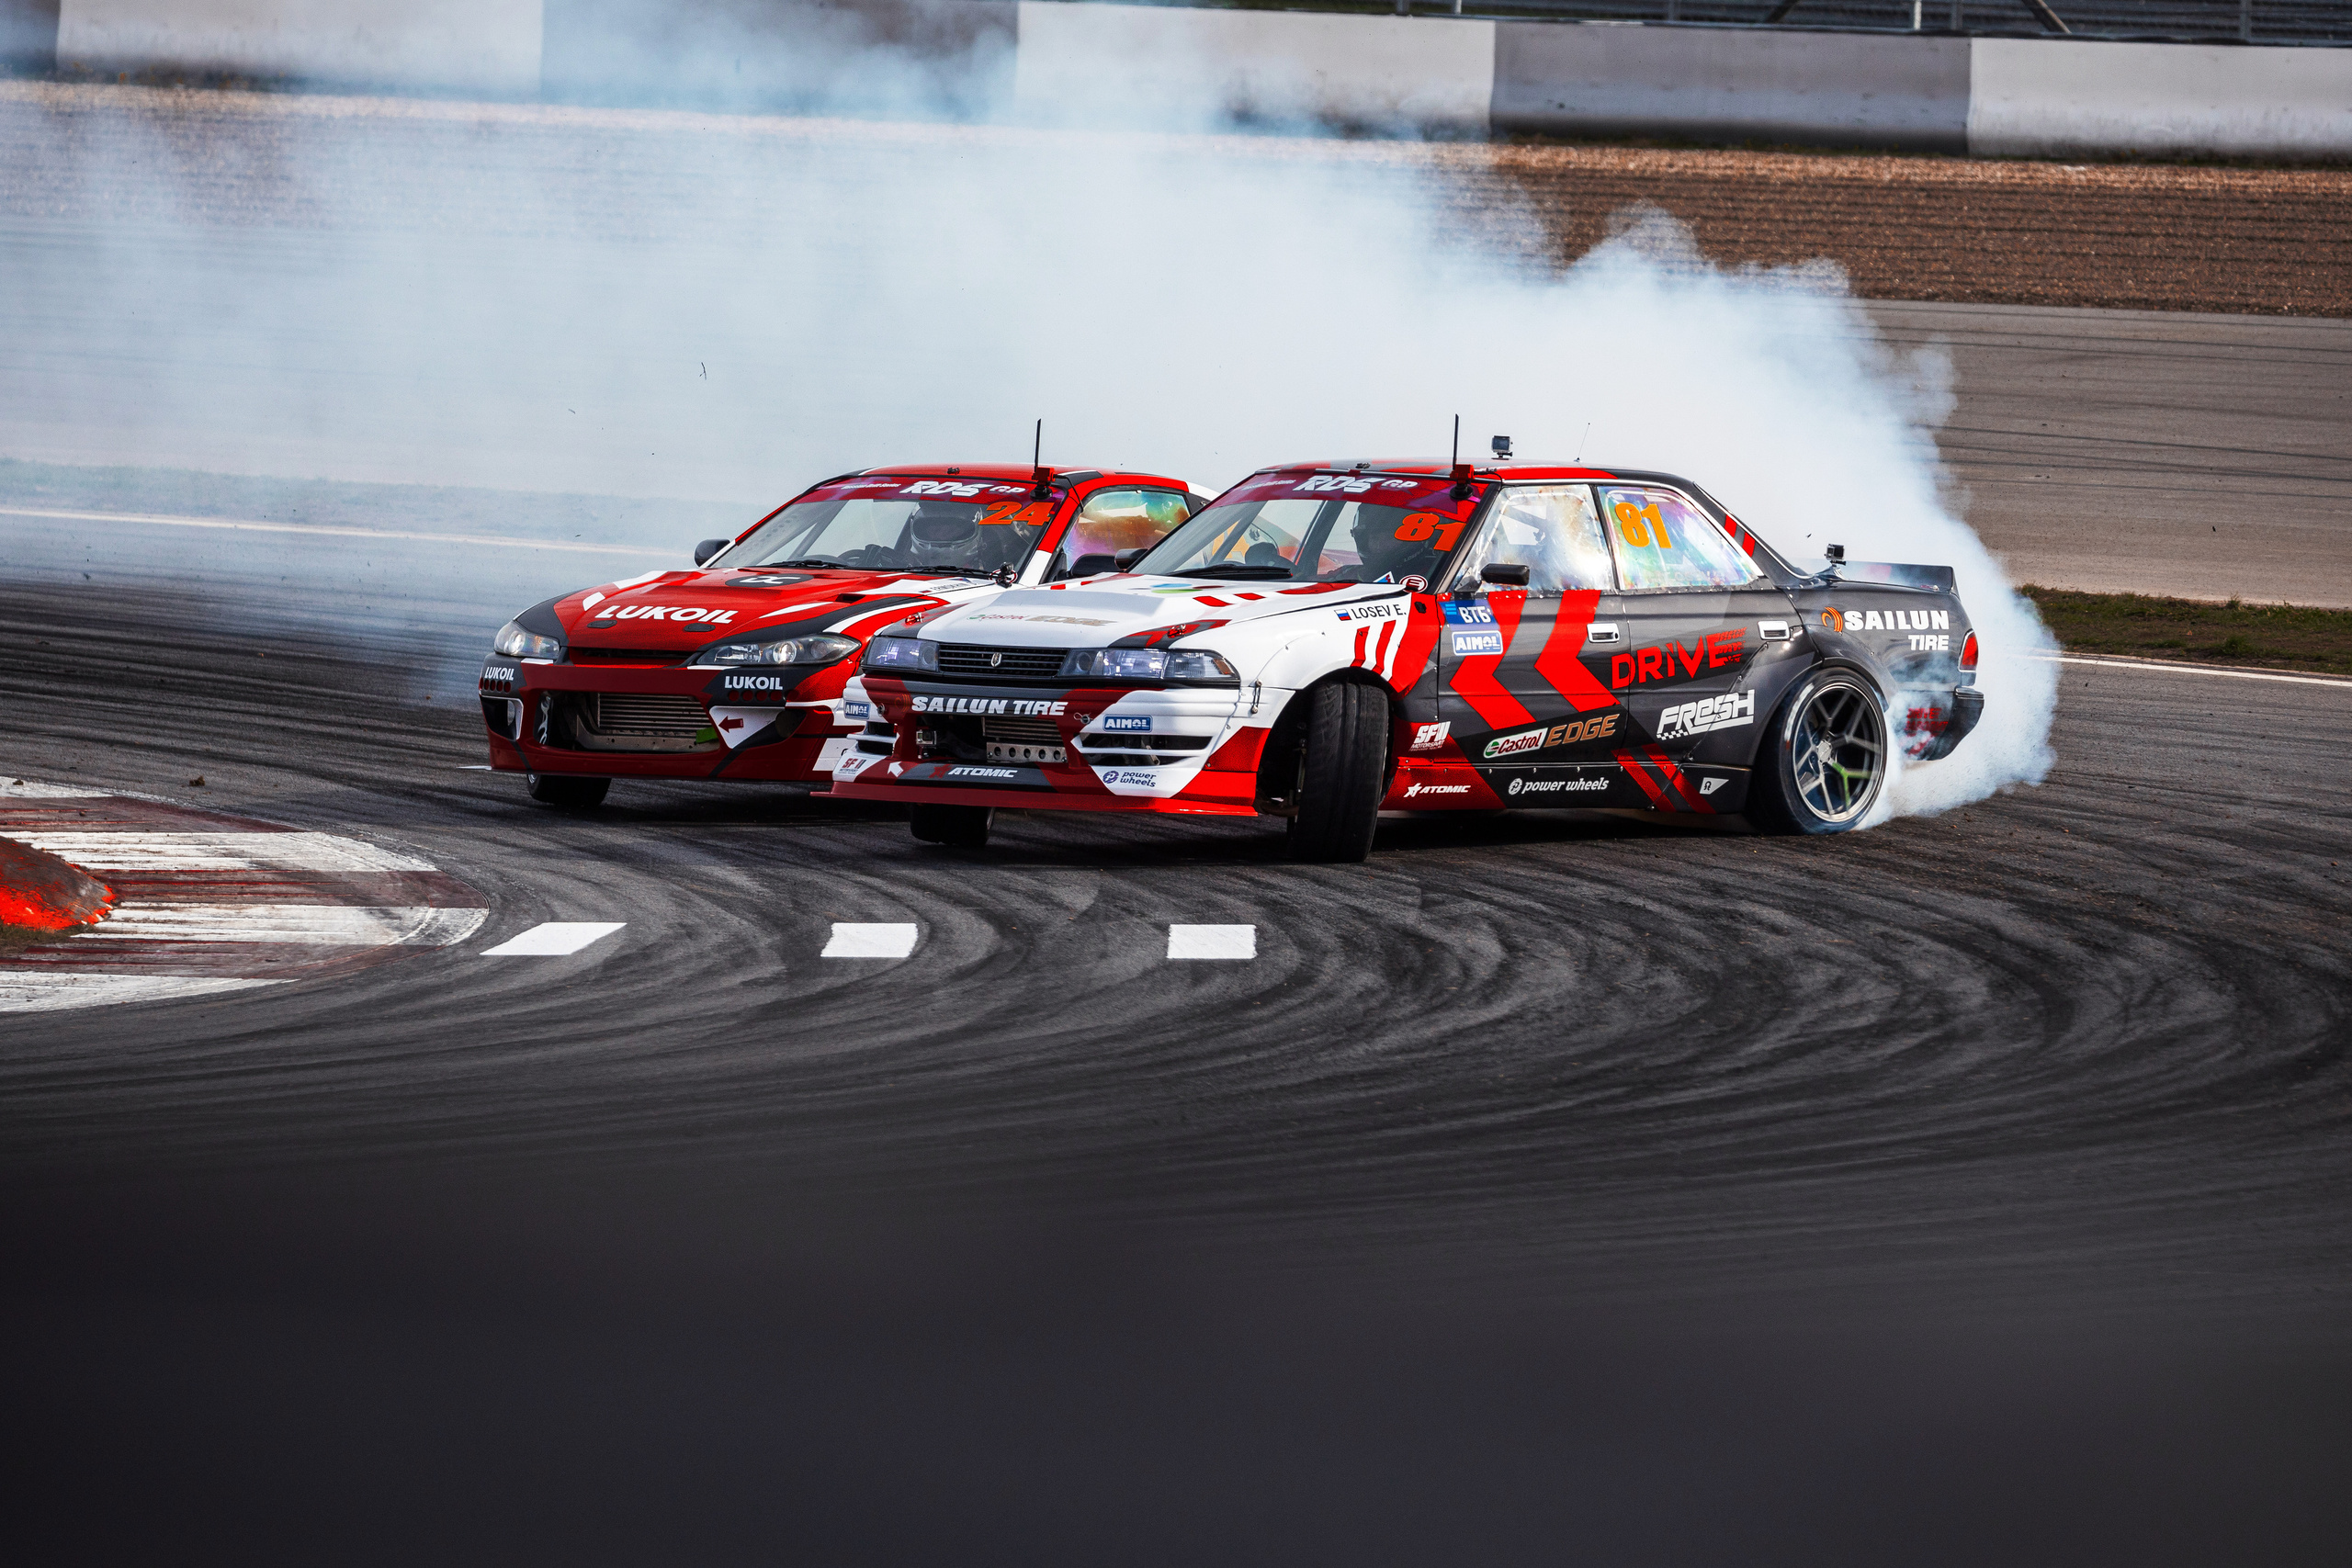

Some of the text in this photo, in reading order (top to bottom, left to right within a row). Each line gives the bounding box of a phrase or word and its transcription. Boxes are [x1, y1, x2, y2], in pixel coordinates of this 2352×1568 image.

[899, 480, 1027, 497] RDS GP
[1293, 475, 1386, 493] RDS
[1380, 479, 1419, 489] GP
[978, 501, 1056, 526] 24
[1394, 513, 1467, 552] 81
[1614, 502, 1672, 549] 81
[594, 604, 739, 625] LUKOIL
[1351, 604, 1407, 619] LOSEV E.
[1843, 610, 1950, 631] SAILUN
[1455, 635, 1501, 651] AIMOL
[1907, 635, 1950, 651] TIRE
[484, 666, 514, 681] LUKOIL
[724, 676, 784, 690] LUKOIL
[845, 703, 868, 716] AIMOL
[911, 696, 1069, 716] SAILUN TIRE
[1104, 718, 1150, 729] AIMOL
[1498, 714, 1620, 754] Castrol EDGE
[948, 767, 1018, 778] ATOMIC
[1122, 772, 1157, 780] power
[1120, 777, 1157, 787] wheels
[1419, 785, 1472, 794] ATOMIC
[1521, 777, 1610, 795] power wheels
